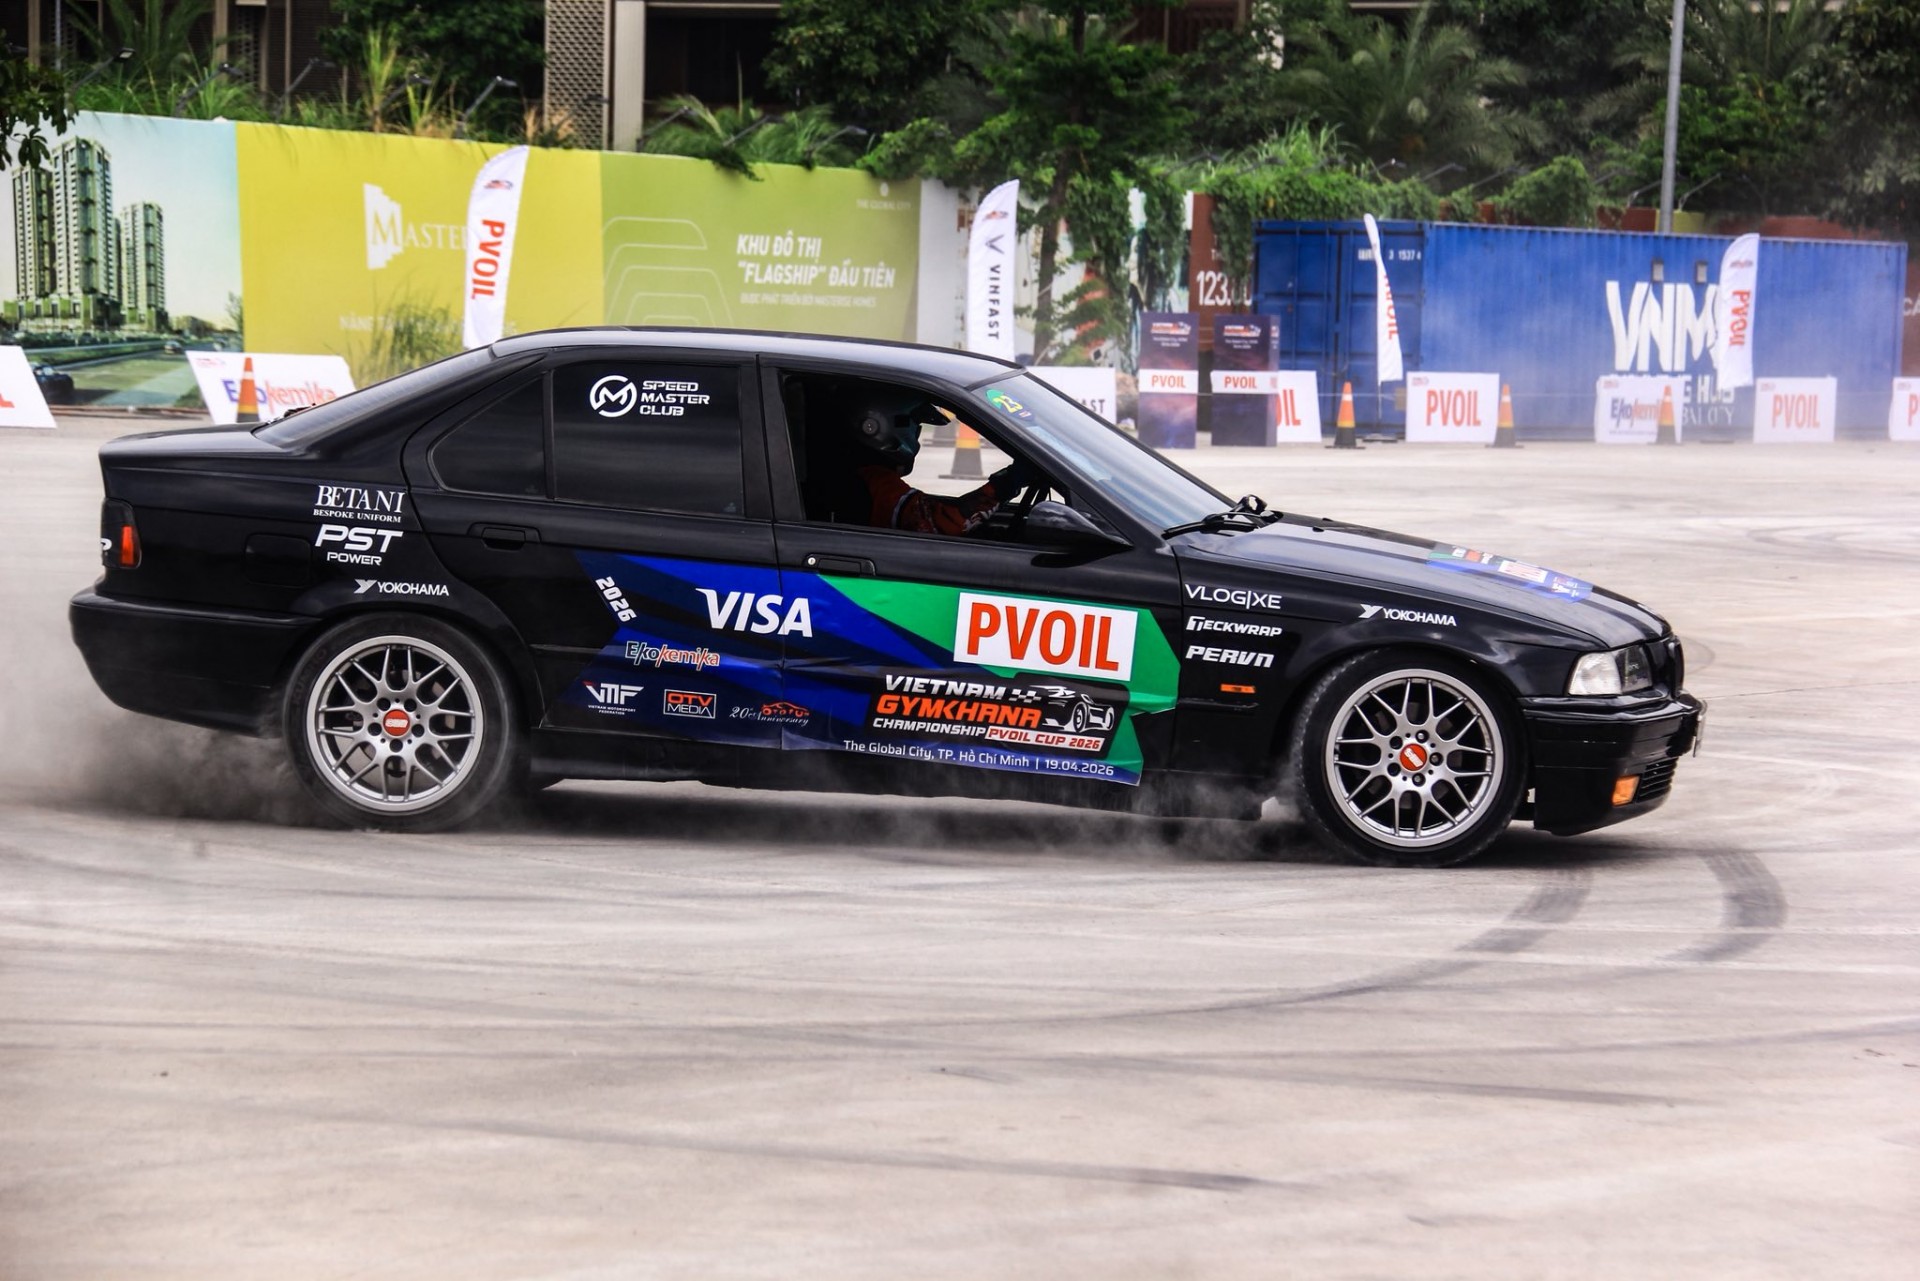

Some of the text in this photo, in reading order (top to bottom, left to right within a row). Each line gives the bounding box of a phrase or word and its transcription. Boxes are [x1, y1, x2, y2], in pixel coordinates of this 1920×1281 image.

[472, 219, 505, 300] PVOIL
[737, 229, 822, 264] KHU ĐÔ THỊ
[863, 261, 895, 289] TIÊN
[987, 264, 1001, 341] VINFAST
[642, 380, 699, 392] SPEED
[1151, 375, 1187, 388] PVOIL
[1224, 376, 1258, 389] PVOIL
[639, 405, 685, 416] CLUB
[640, 392, 711, 405] MASTER
[1426, 390, 1482, 427] PVOIL
[1772, 394, 1820, 428] PVOIL
[315, 485, 405, 513] BETANI
[313, 508, 401, 523] BESPOKE UNIFORM
[315, 524, 404, 553] PST
[327, 551, 382, 566] POWER
[377, 581, 450, 597] YOKOHAMA
[595, 576, 637, 623] 2026
[695, 587, 813, 638] VISA
[1382, 607, 1457, 627] YOKOHAMA
[967, 602, 1119, 671] PVOIL
[624, 640, 721, 672] Ekokemika
[885, 674, 1005, 701] VIETNAM
[667, 703, 713, 719] MEDIA
[876, 694, 1042, 729] GYMKHANA
[873, 717, 1101, 750] CHAMPIONSHIP PVOIL CUP 2026
[843, 740, 866, 752] The
[868, 742, 906, 756] Global
[908, 746, 935, 760] City,
[938, 748, 956, 760] TP.
[959, 749, 976, 762] Hồ
[979, 752, 997, 764] Chí
[1000, 756, 1030, 767] Minh
[1045, 759, 1115, 776] 19.04.2026
